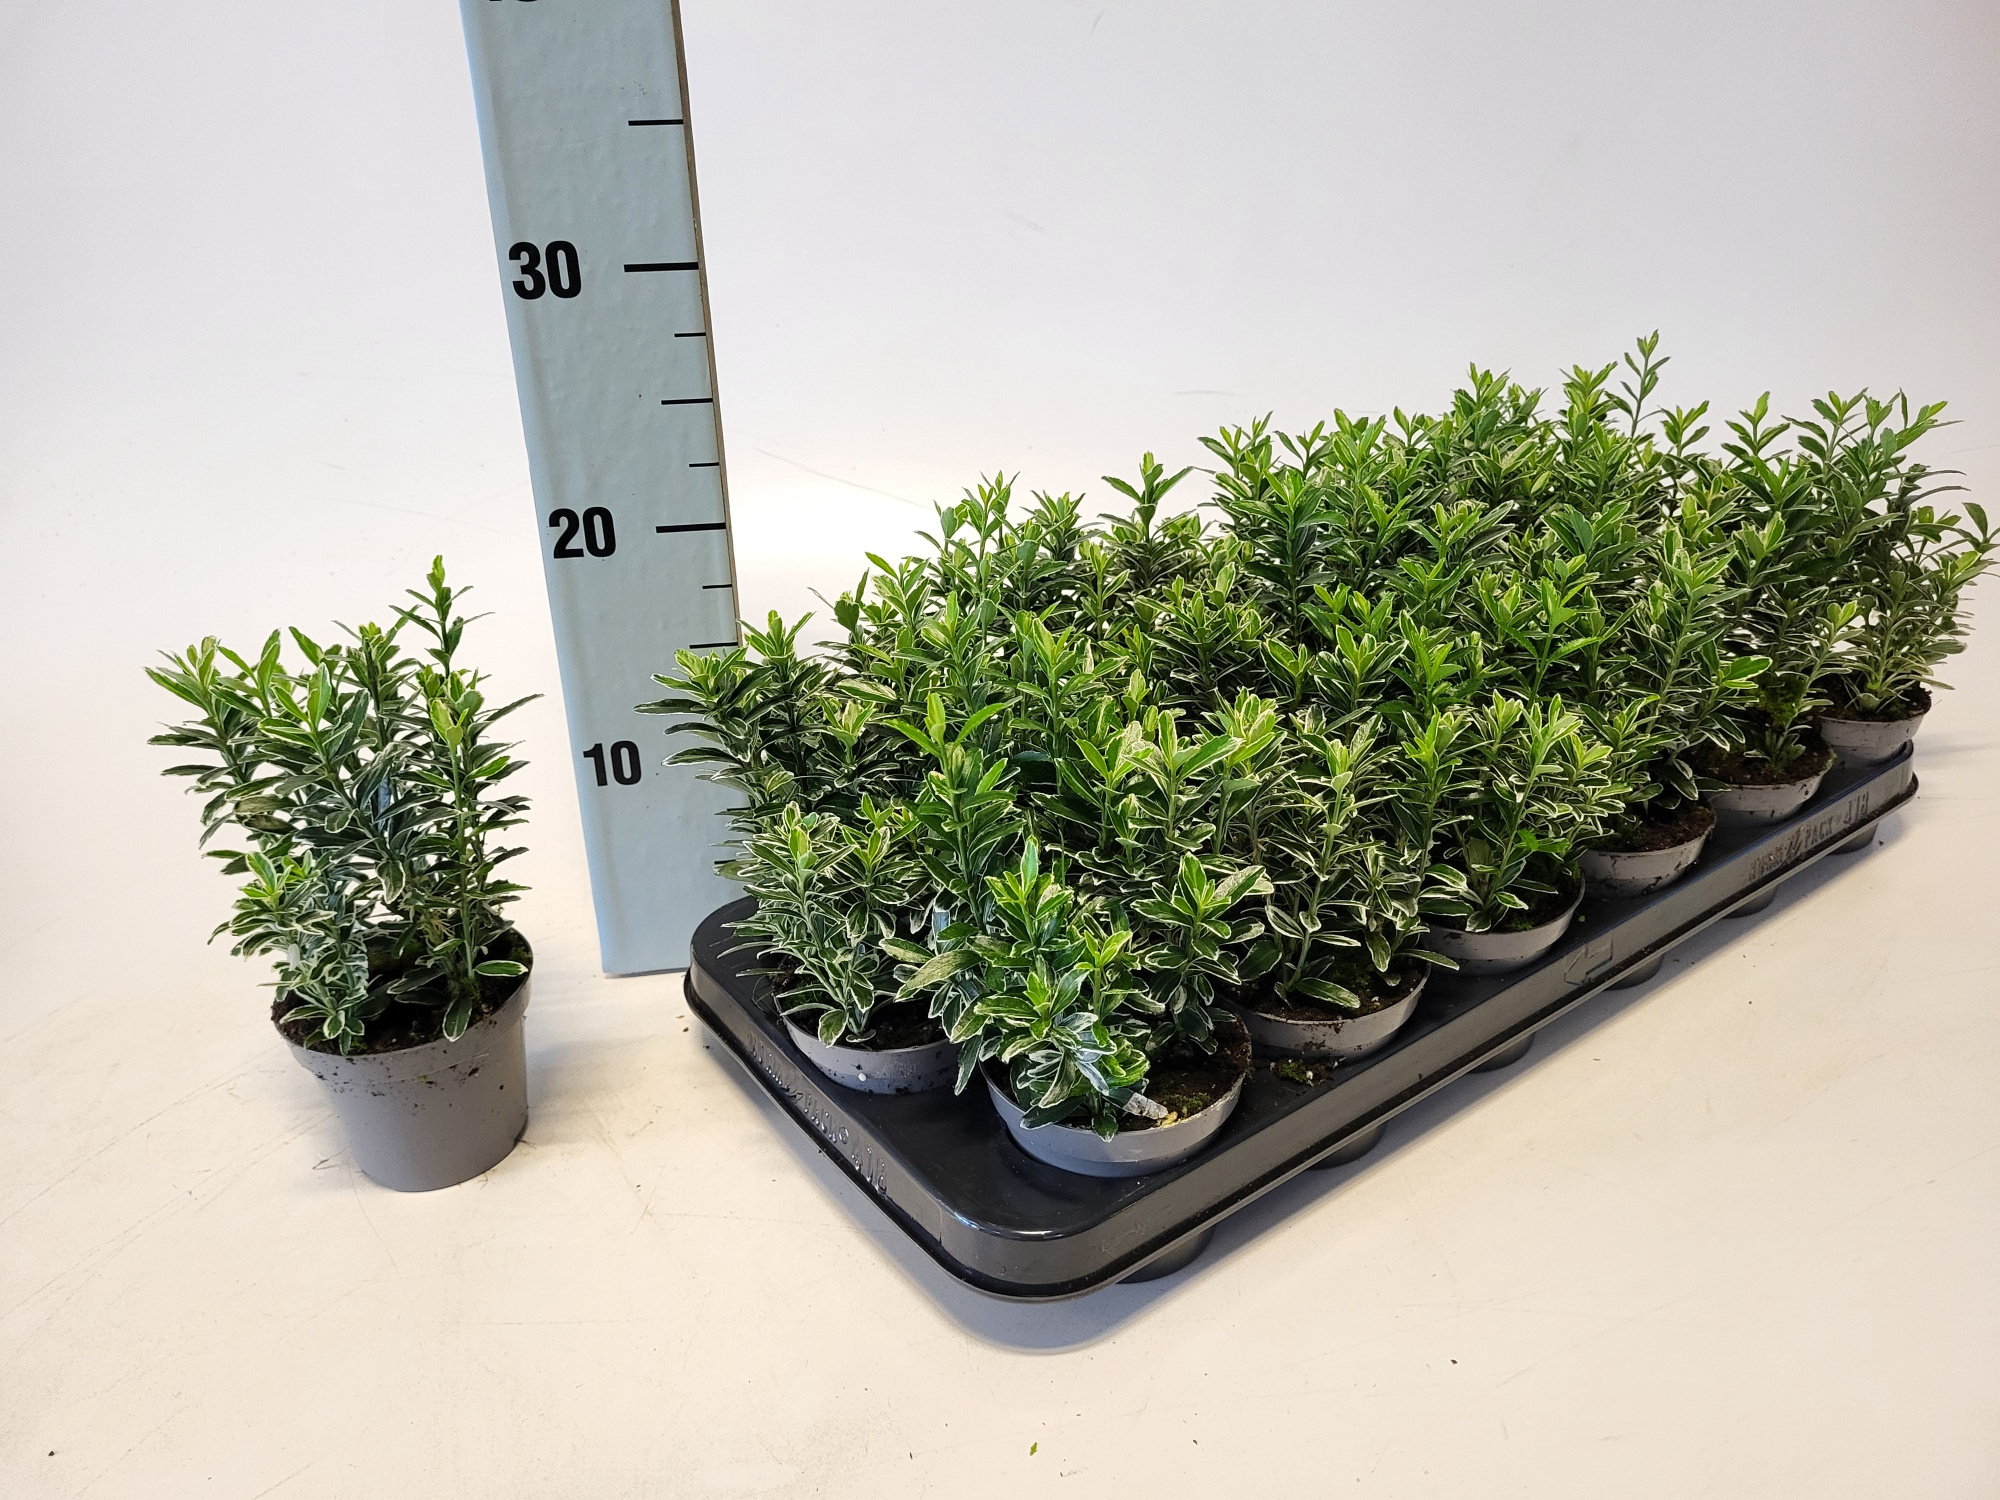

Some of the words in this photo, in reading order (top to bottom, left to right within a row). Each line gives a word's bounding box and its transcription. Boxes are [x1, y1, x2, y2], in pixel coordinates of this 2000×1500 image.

[508, 240, 582, 300] 30
[548, 506, 617, 560] 20
[582, 740, 642, 787] 10
